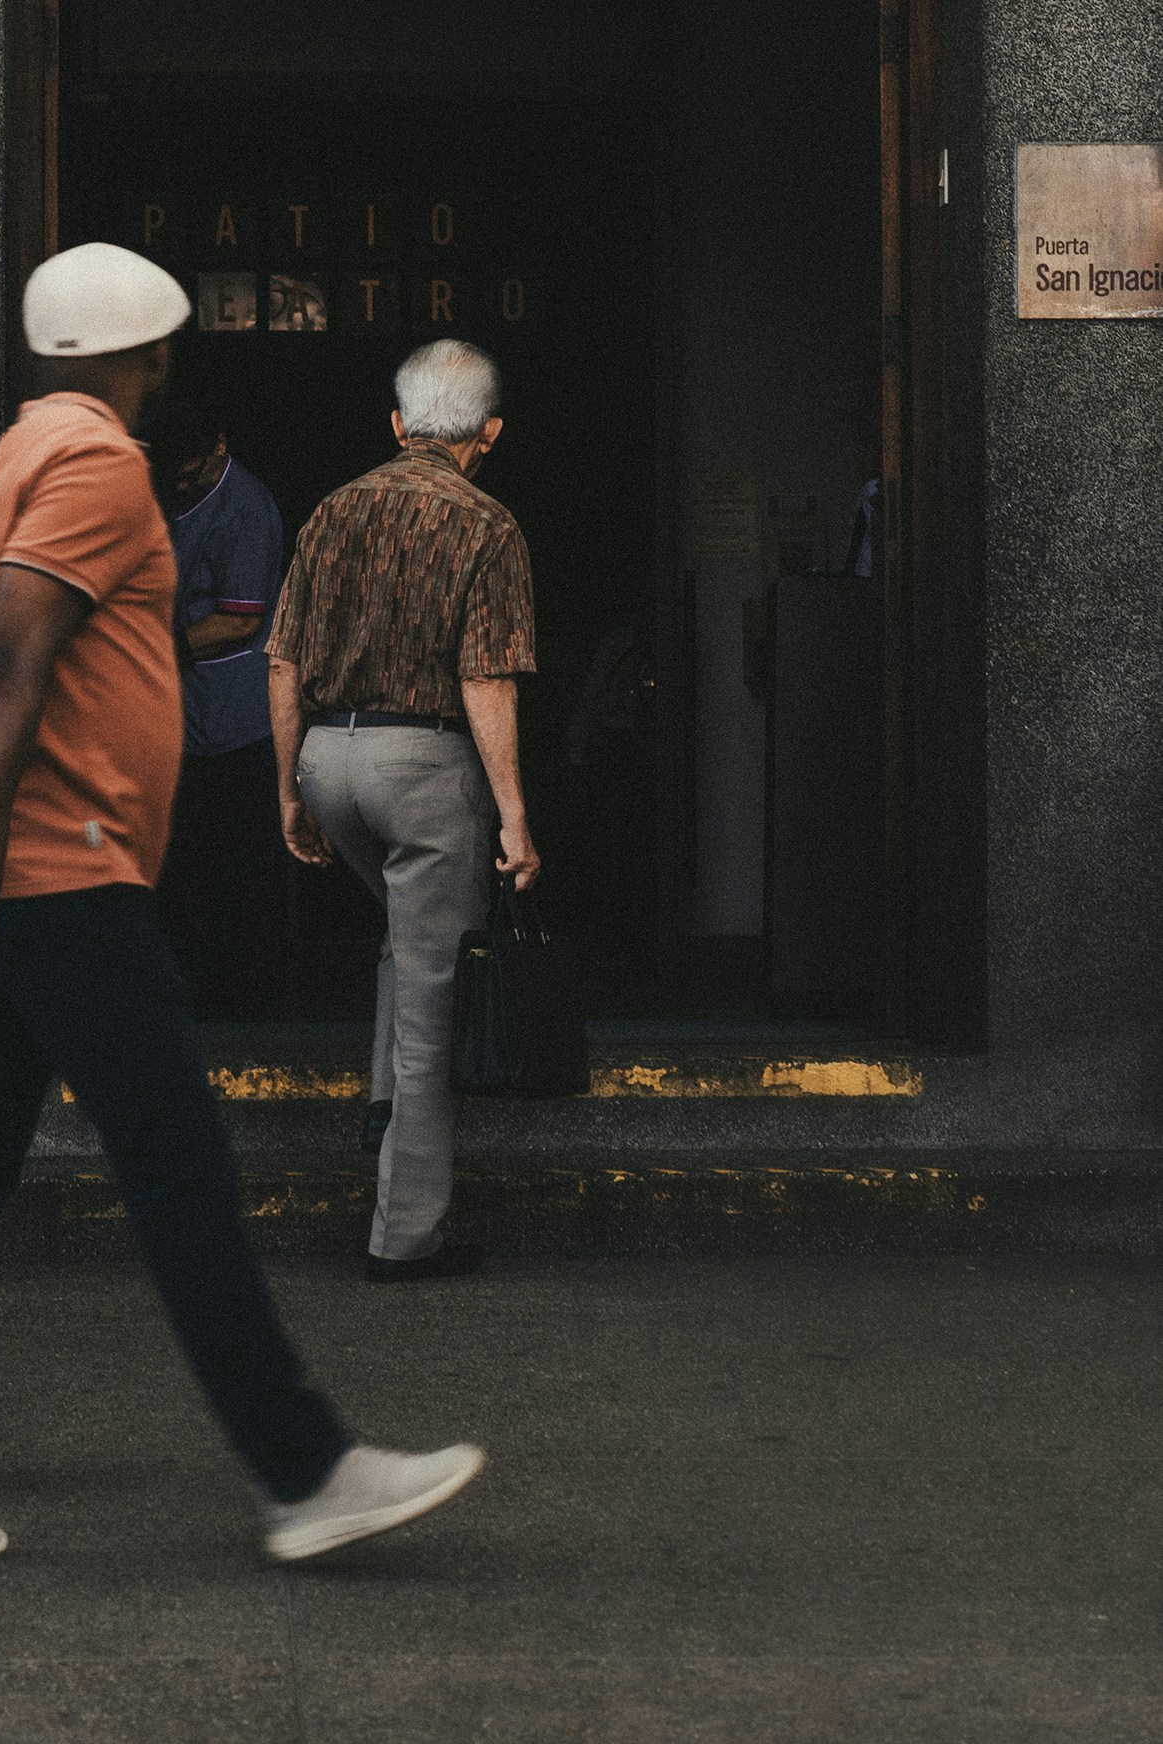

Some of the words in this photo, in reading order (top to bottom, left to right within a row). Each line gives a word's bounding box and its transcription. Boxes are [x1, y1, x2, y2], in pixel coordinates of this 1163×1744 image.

[143, 204, 455, 248] PATIO
[1035, 236, 1089, 255] Puerta
[1036, 263, 1081, 292] San
[217, 278, 525, 323] EATRO
